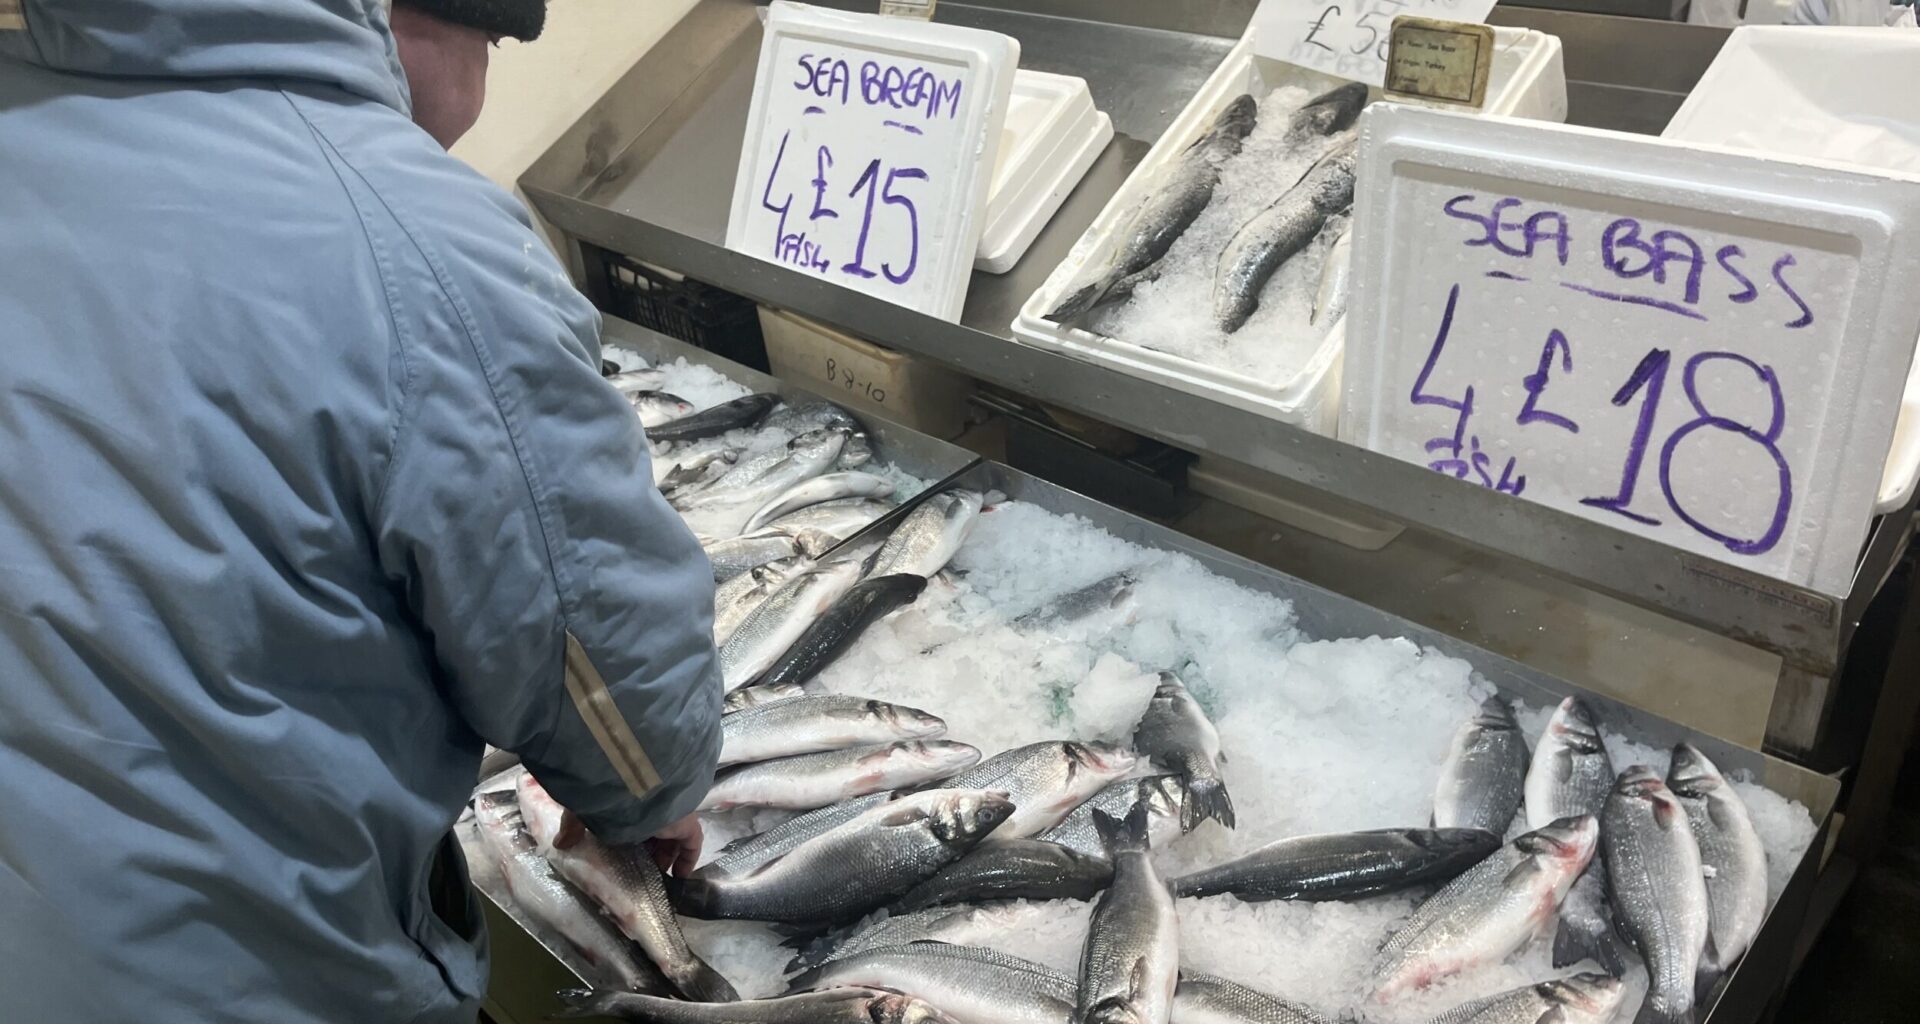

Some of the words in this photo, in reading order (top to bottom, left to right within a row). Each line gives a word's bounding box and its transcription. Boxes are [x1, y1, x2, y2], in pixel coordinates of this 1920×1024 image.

[794, 54, 850, 105] SEA
[860, 60, 962, 120] BREAM
[762, 129, 794, 259] 4
[1443, 195, 1571, 265] SEA
[1601, 217, 1814, 329] BASS
[826, 358, 837, 381] B
[1410, 284, 1474, 458] 4
